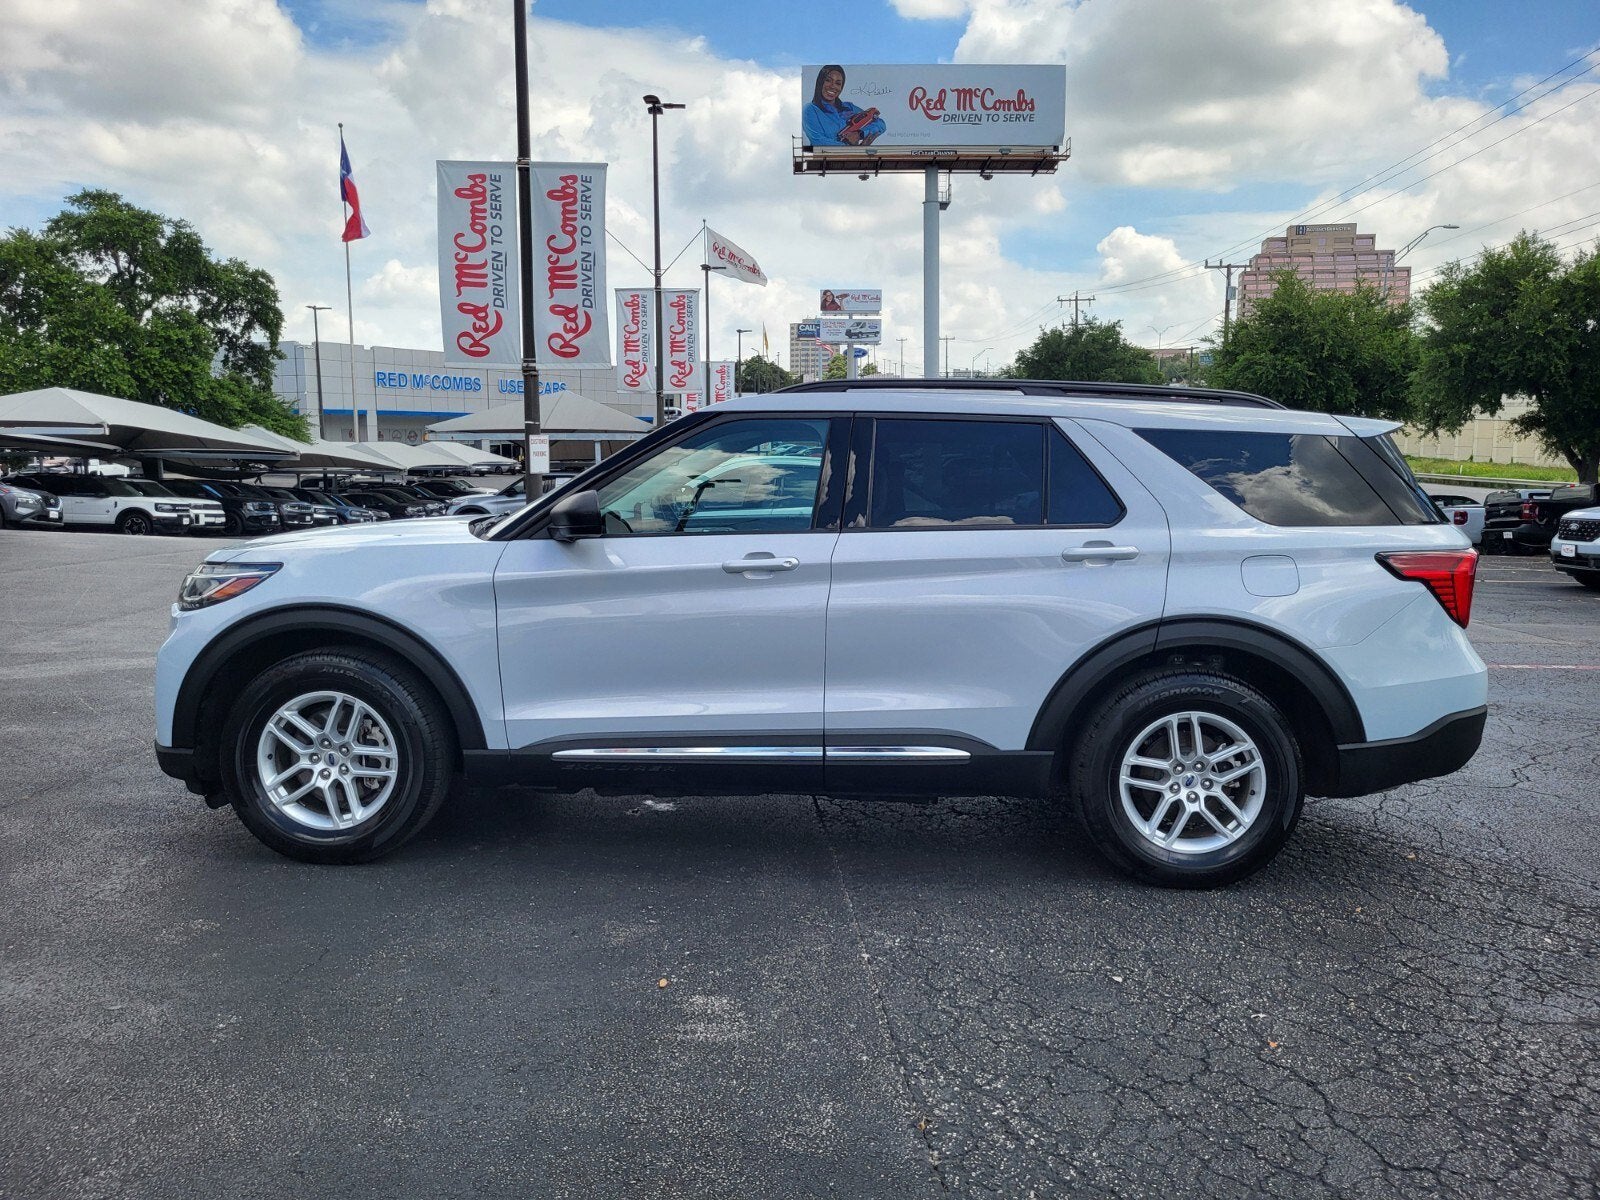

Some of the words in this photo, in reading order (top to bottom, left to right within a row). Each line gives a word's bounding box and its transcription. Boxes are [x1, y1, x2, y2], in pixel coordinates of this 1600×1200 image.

[909, 86, 947, 121] Red
[950, 87, 1035, 112] McCombs
[942, 113, 982, 123] DRIVEN
[986, 113, 1000, 122] TO
[1002, 113, 1035, 122] SERVE
[490, 174, 502, 221] SERVE
[580, 174, 592, 222] SERVE
[453, 173, 488, 298] McCombs
[490, 225, 503, 248] TO
[546, 174, 579, 299] McCombs
[580, 225, 592, 248] TO
[490, 251, 505, 309] DRIVEN
[580, 251, 594, 309] DRIVEN
[456, 302, 503, 358] Red
[547, 304, 592, 358] Red
[623, 293, 640, 357] McCombs
[641, 319, 648, 331] TO
[669, 294, 686, 357] McCombs
[686, 319, 694, 331] TO
[687, 333, 695, 363] DRIVEN
[376, 371, 408, 388] RED
[499, 378, 525, 393] USE
[538, 381, 567, 395] CARS
[623, 359, 647, 388] Red
[670, 360, 693, 388] Red
[715, 364, 726, 403] McCombs
